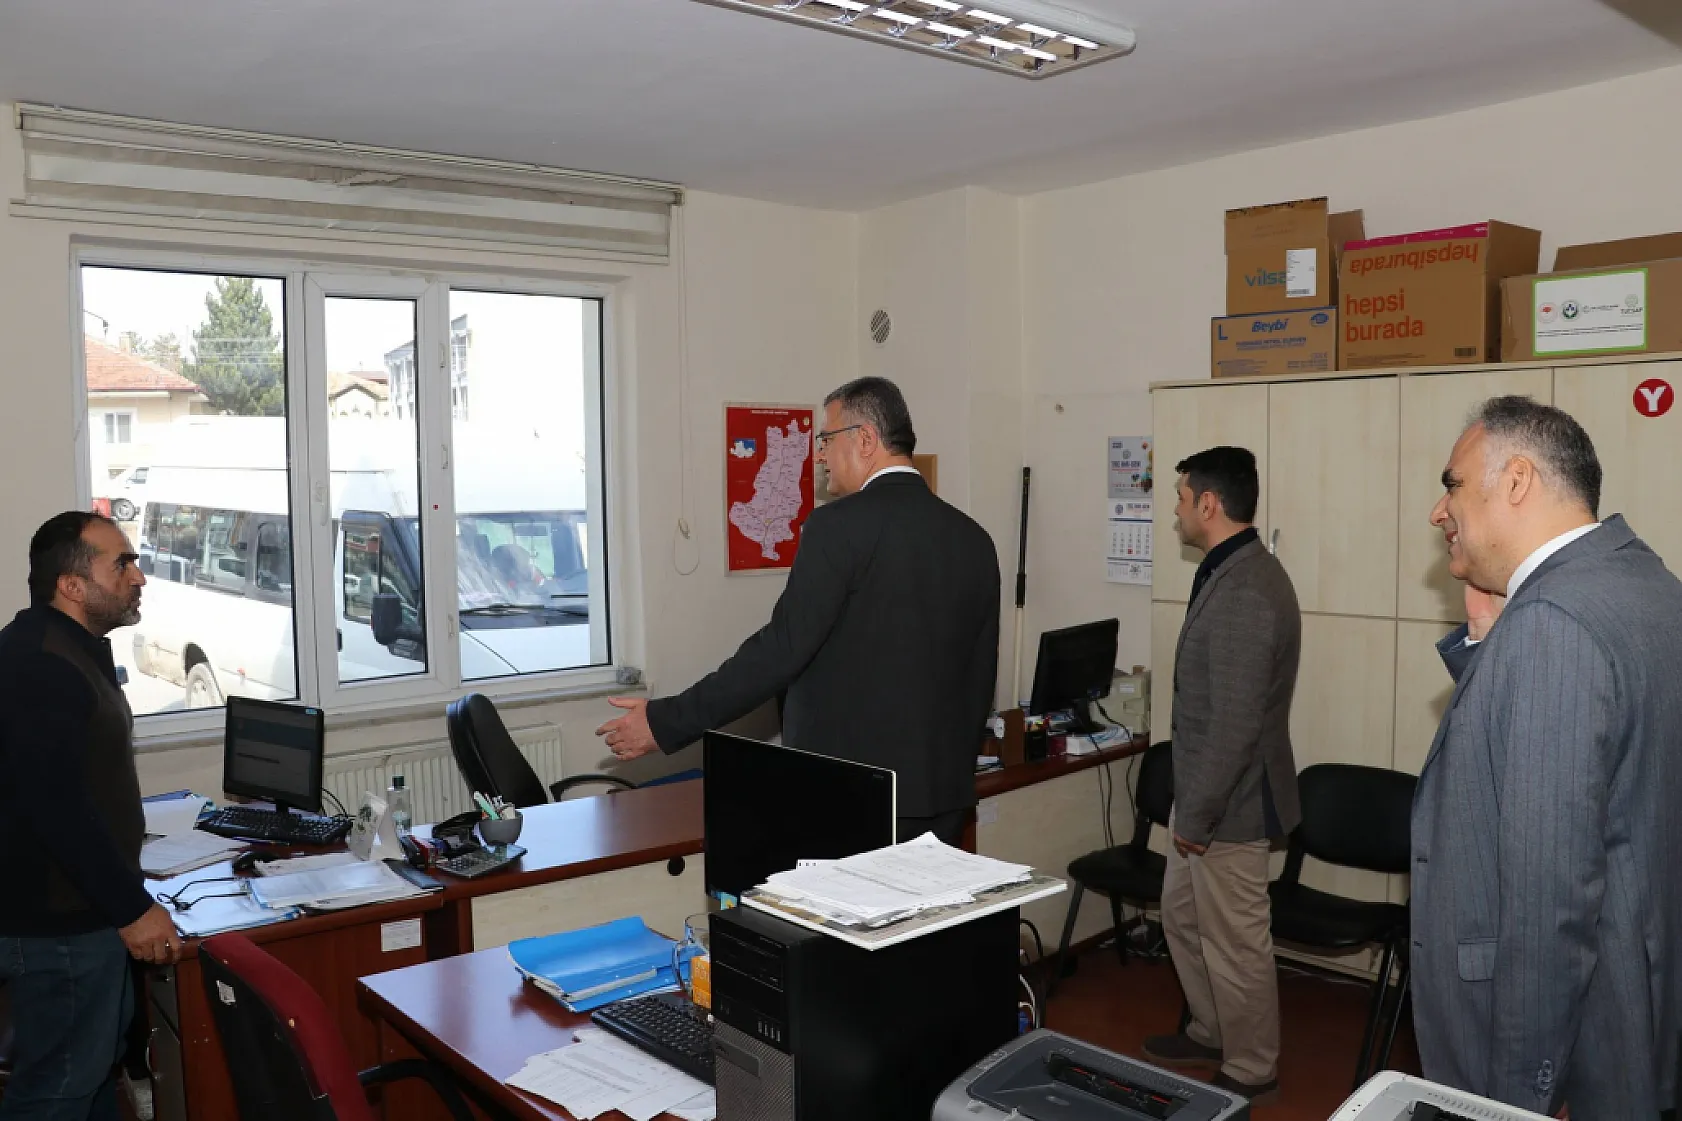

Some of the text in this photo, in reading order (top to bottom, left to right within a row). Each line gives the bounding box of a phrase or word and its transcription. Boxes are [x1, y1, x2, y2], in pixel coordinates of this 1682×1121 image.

[1350, 242, 1478, 275] hepsiburada
[1346, 288, 1405, 319] hepsi
[1218, 324, 1228, 340] L
[1252, 319, 1288, 333] Beybi
[1346, 315, 1424, 342] burada
[1640, 386, 1666, 412] Y
